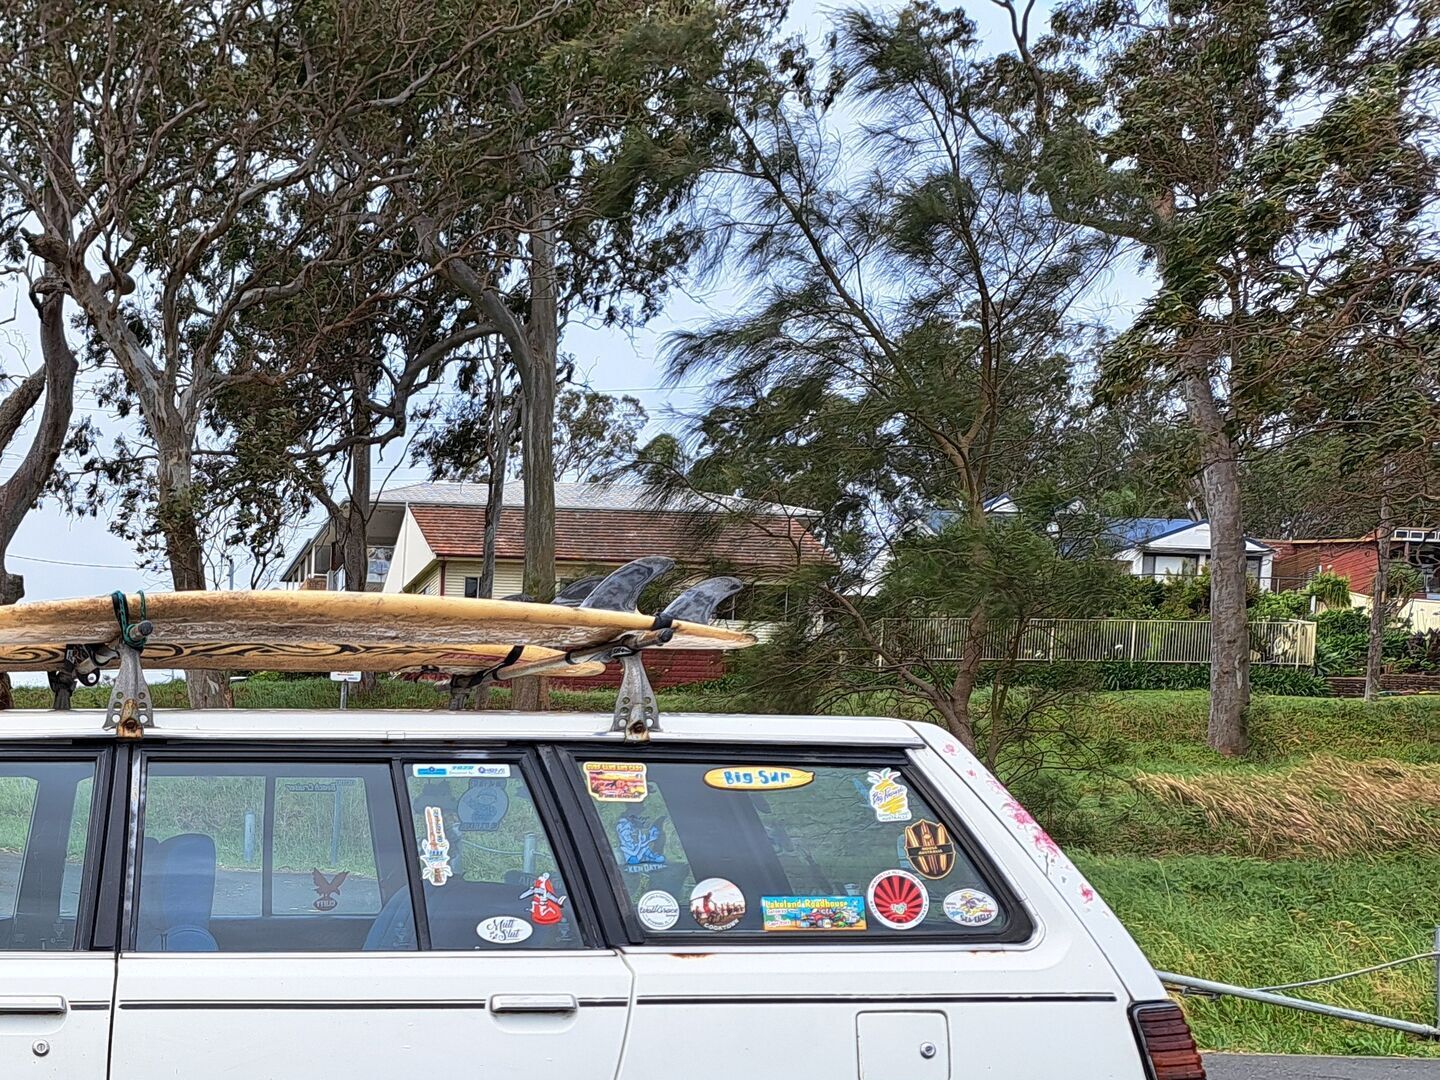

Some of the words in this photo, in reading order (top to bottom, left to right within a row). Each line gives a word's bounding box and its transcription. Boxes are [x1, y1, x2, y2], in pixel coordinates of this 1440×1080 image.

[724, 770, 754, 784] Big
[758, 770, 791, 784] Sur
[765, 900, 801, 909] Lakeland
[804, 898, 849, 909] Roadhouse
[486, 919, 517, 932] Mutt
[703, 918, 740, 930] COOKTOWN
